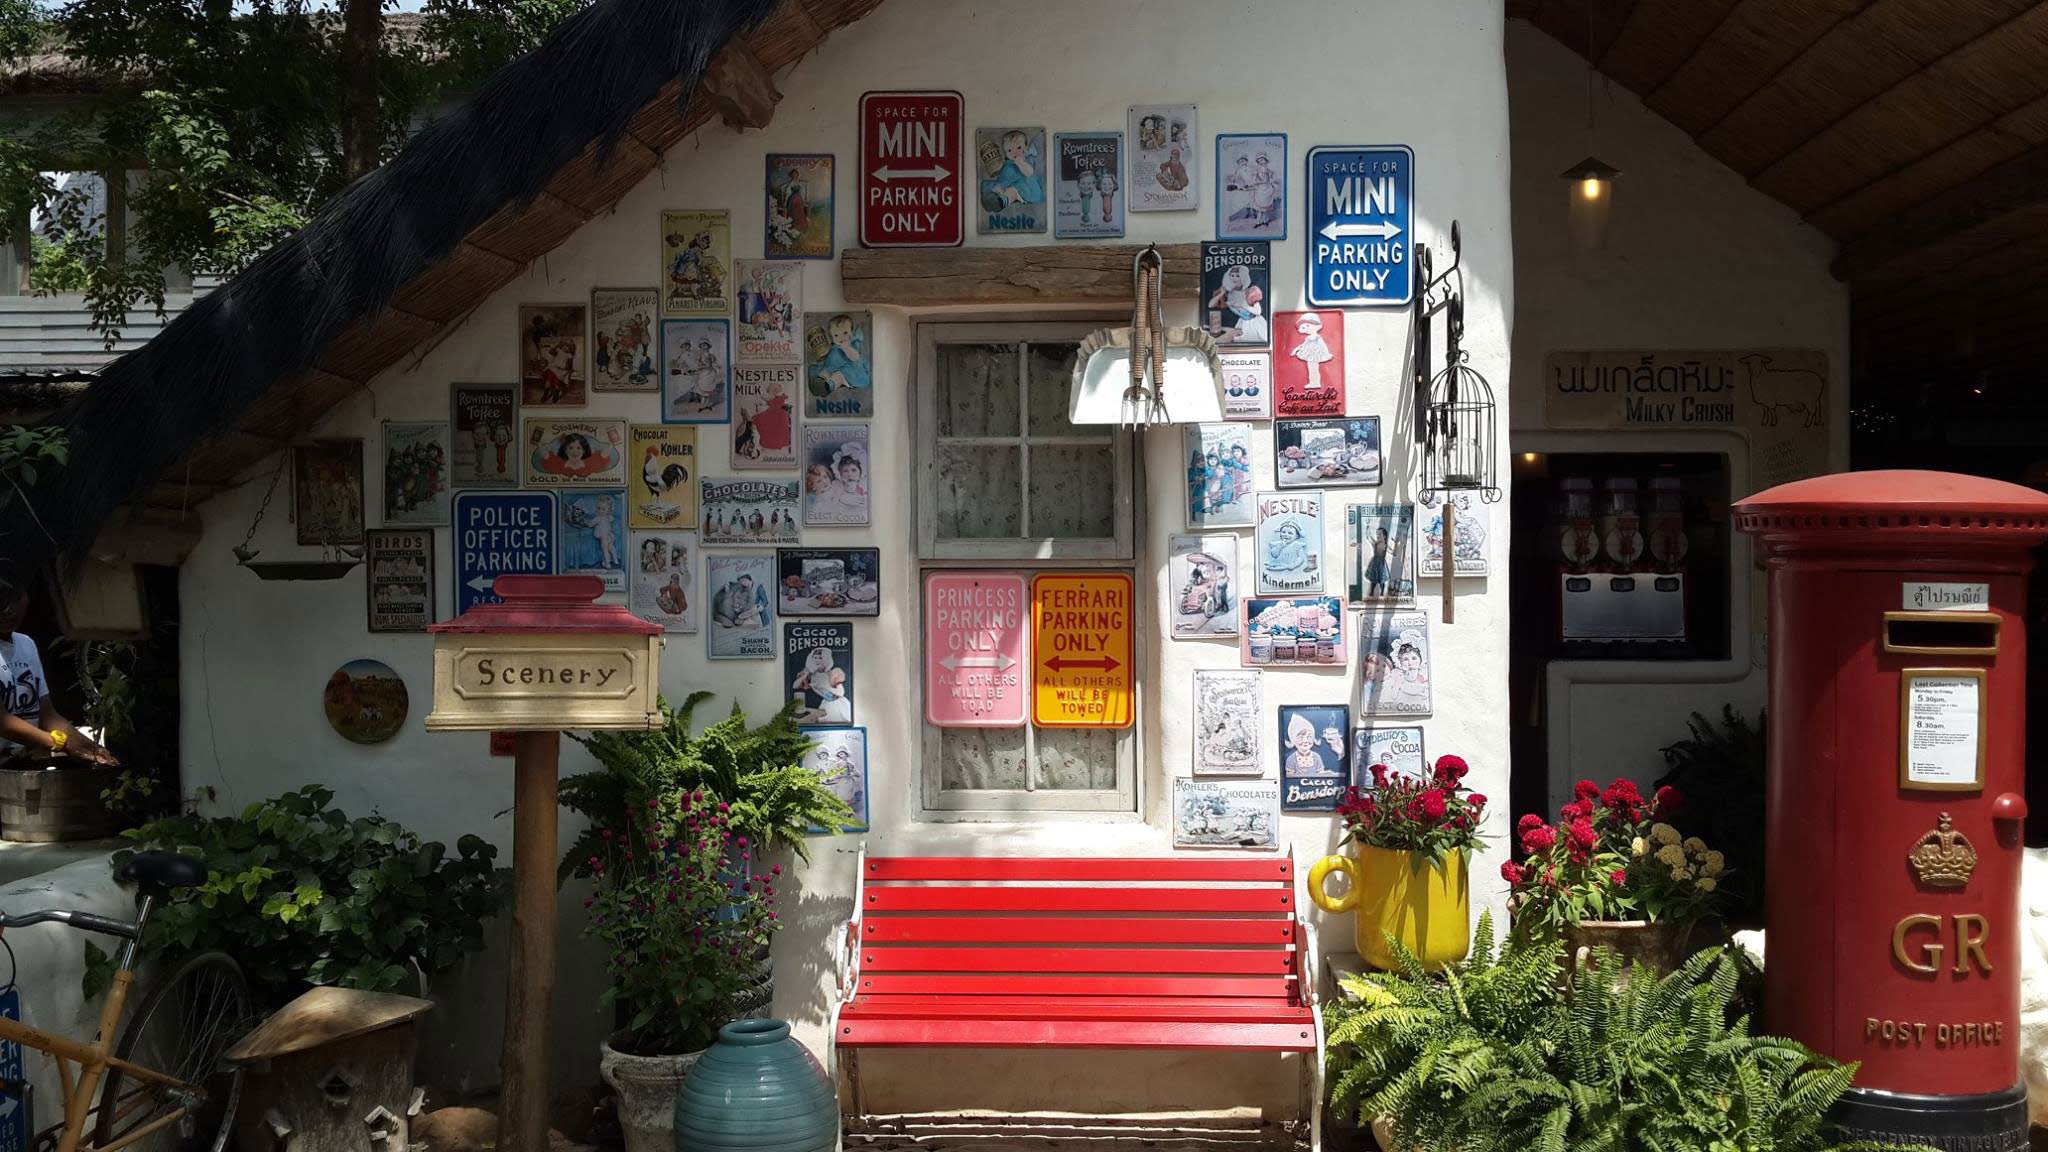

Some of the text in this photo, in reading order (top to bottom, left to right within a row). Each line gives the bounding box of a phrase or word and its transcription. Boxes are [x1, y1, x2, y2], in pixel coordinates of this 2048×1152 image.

[876, 107, 949, 118] SPACE FOR
[878, 122, 945, 158] MINI
[1324, 162, 1398, 174] SPACE FOR
[871, 187, 953, 206] PARKING
[1327, 177, 1396, 215] MINI
[882, 212, 941, 232] ONLY
[1208, 245, 1254, 255] Cacao
[1318, 243, 1404, 265] PARKING
[1205, 255, 1266, 273] BENSDORP
[1330, 269, 1390, 291] ONLY
[627, 295, 657, 310] KLAUS
[735, 385, 762, 396] MILK
[1300, 405, 1314, 413] au
[1317, 400, 1341, 413] Lait
[1625, 395, 1735, 423] MILKY CRUSH
[633, 429, 669, 442] CHOCOLAT
[660, 443, 693, 457] KOHLER
[530, 475, 559, 483] GOLD
[704, 482, 786, 499] CHOCOLATES
[470, 507, 541, 527] POLICE
[464, 528, 547, 549] OFFICER
[464, 551, 547, 571] PARKING
[1262, 571, 1320, 590] Kindermehl
[937, 588, 1016, 608] PRINCESS
[1042, 590, 1123, 608] FERRARI
[1913, 586, 1982, 607] ตู้ไปรษณีย์
[937, 609, 1017, 629] PARKING
[1043, 611, 1123, 630] PARKING
[792, 626, 837, 637] Cacao
[949, 630, 1005, 651] ONLY
[741, 646, 770, 654] BACON
[789, 637, 849, 655] BENSDORP
[1055, 633, 1110, 652] ONLY
[477, 658, 617, 687] Scenery
[939, 674, 1017, 686] ALL OTHERS
[1044, 676, 1122, 687] ALL OTHERS
[951, 687, 1004, 700] WILL BE
[1056, 690, 1108, 700] WILL BE
[960, 700, 994, 712] TOAD
[1061, 703, 1104, 714] TOWED
[1397, 702, 1427, 712] COCOA
[1357, 730, 1408, 750] CADBURY'S
[1390, 741, 1420, 755] COCOA
[1300, 778, 1334, 787] CACAO
[1219, 787, 1277, 800] CHOCOLATES
[1286, 785, 1346, 803] Bensdorp
[1892, 913, 1993, 974] GR
[1866, 1018, 2004, 1045] POST OFFICE
